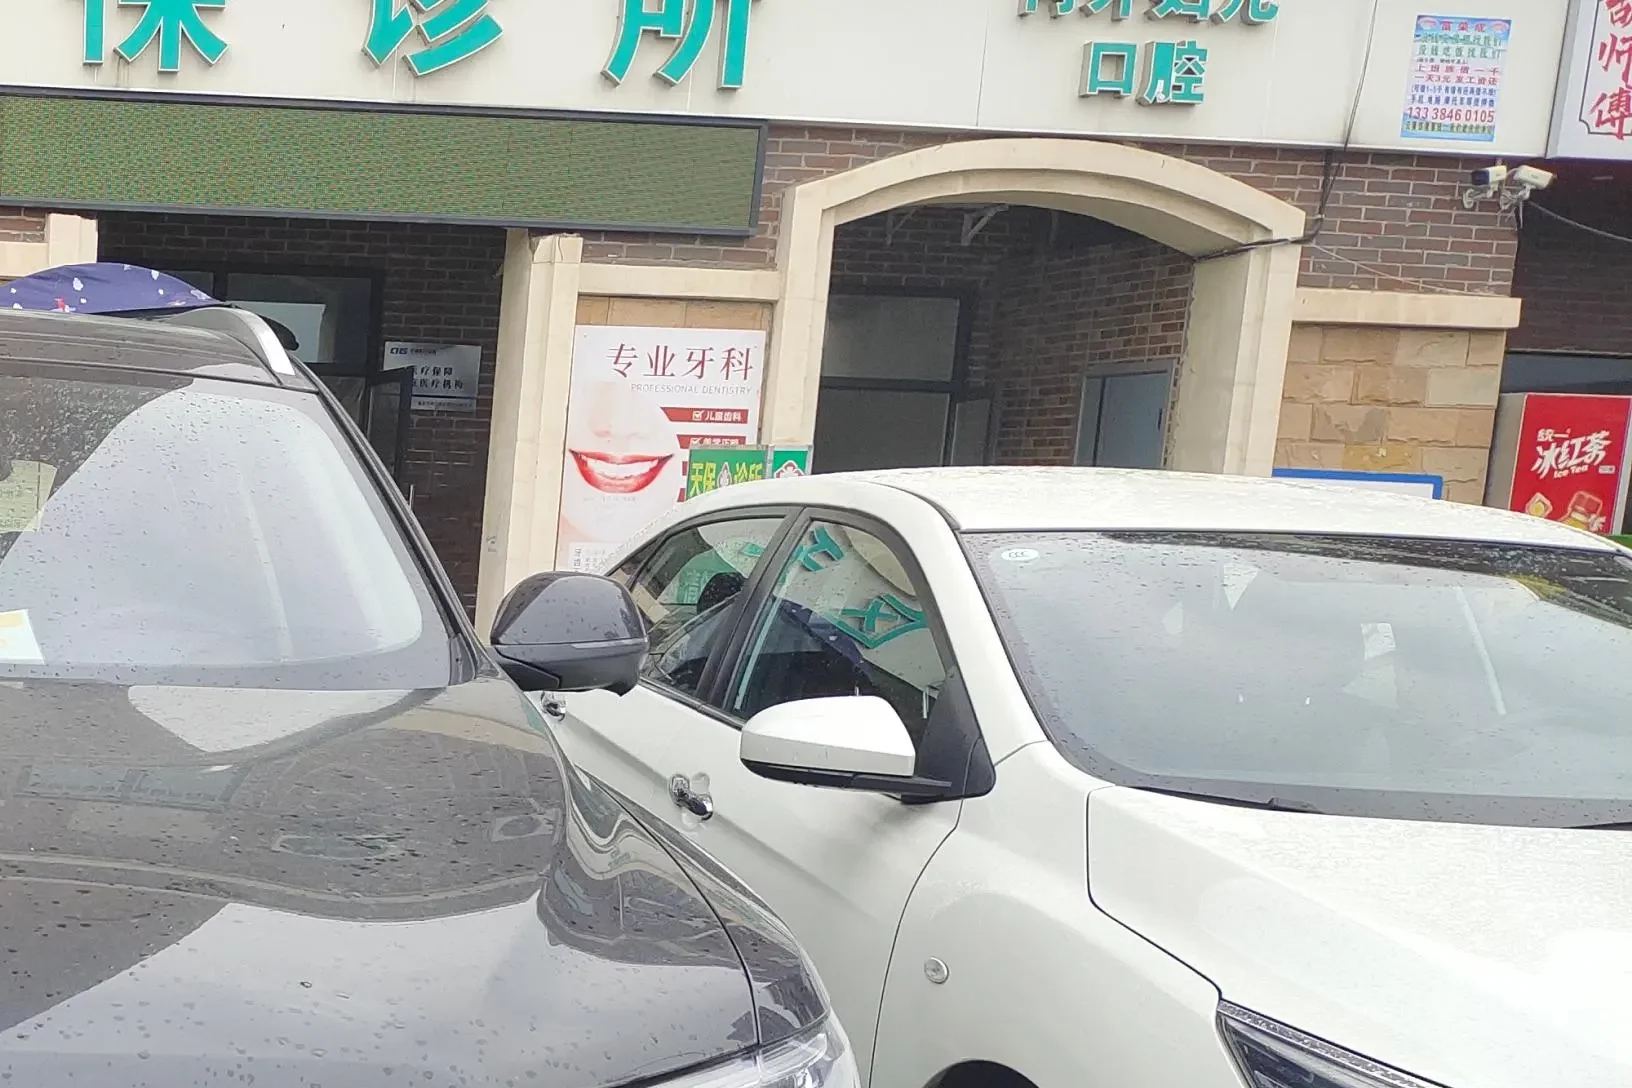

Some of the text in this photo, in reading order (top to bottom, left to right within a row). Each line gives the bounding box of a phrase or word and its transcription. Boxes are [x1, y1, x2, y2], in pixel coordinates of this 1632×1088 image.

[1082, 40, 1208, 103] 口腔
[1408, 107, 1495, 123] 133 3846 0105
[606, 343, 755, 381] 专业牙科
[631, 383, 753, 395] PROFESSIONAL DENTISTRY
[1530, 430, 1612, 480] 冰红茶
